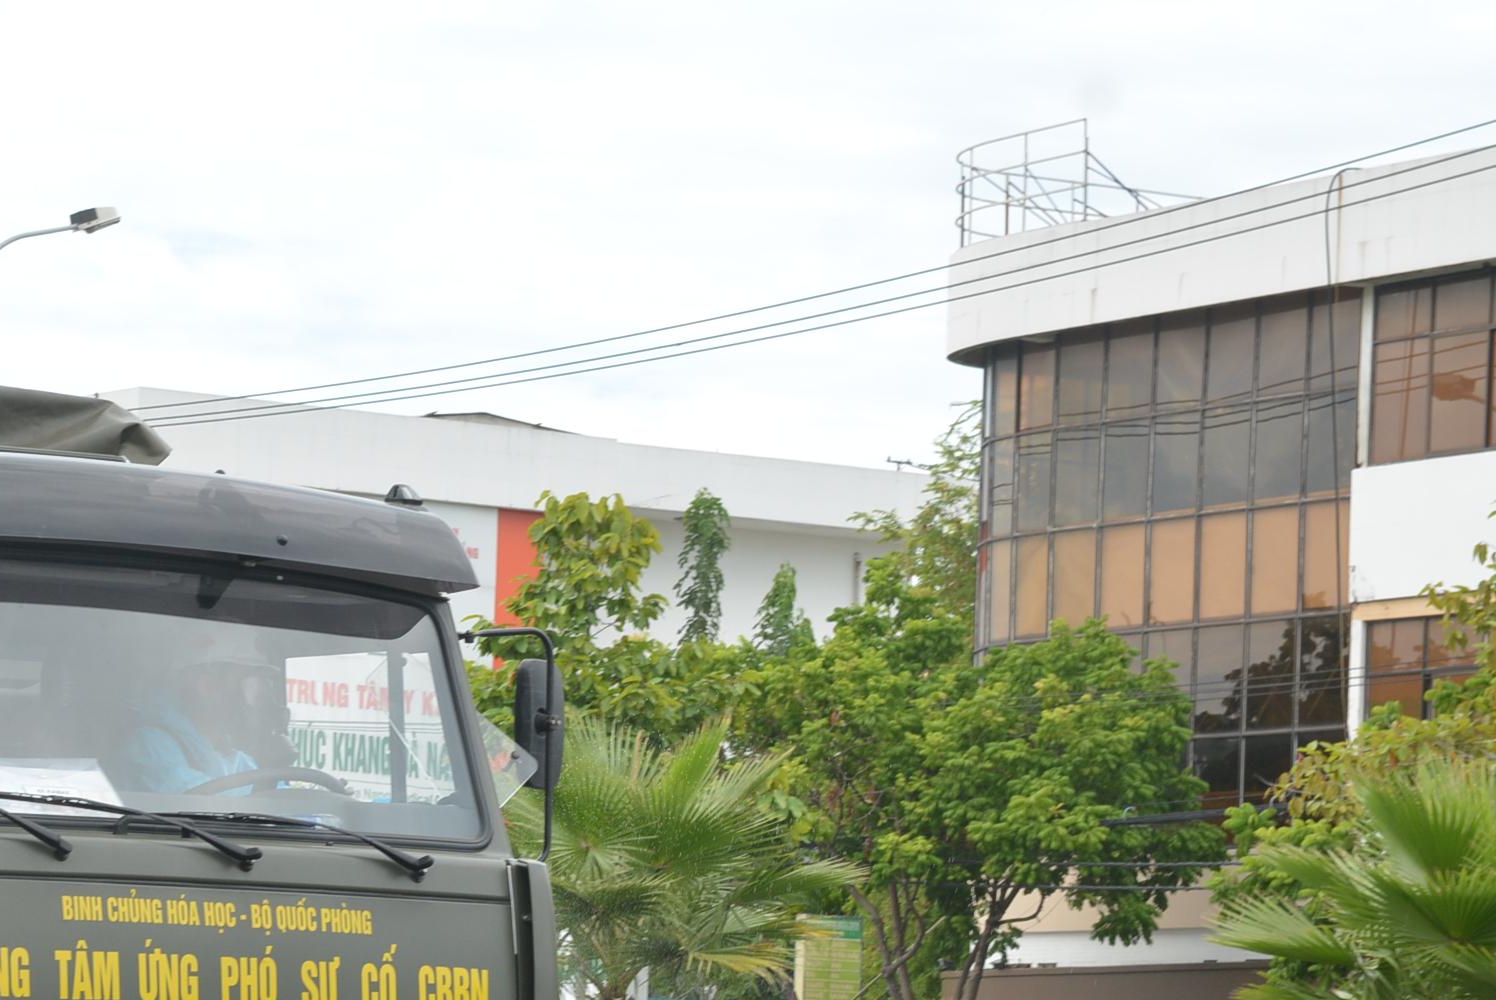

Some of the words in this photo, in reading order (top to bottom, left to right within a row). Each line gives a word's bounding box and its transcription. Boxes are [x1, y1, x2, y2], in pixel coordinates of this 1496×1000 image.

[61, 895, 104, 921] BINH
[106, 888, 164, 924] CHỦNG
[167, 894, 201, 926] HÓA
[203, 901, 236, 933] HỌC
[250, 899, 273, 936] BỘ
[276, 897, 318, 933] QUỐC
[320, 902, 373, 935] PHÒNG
[54, 939, 121, 1000] TÂM
